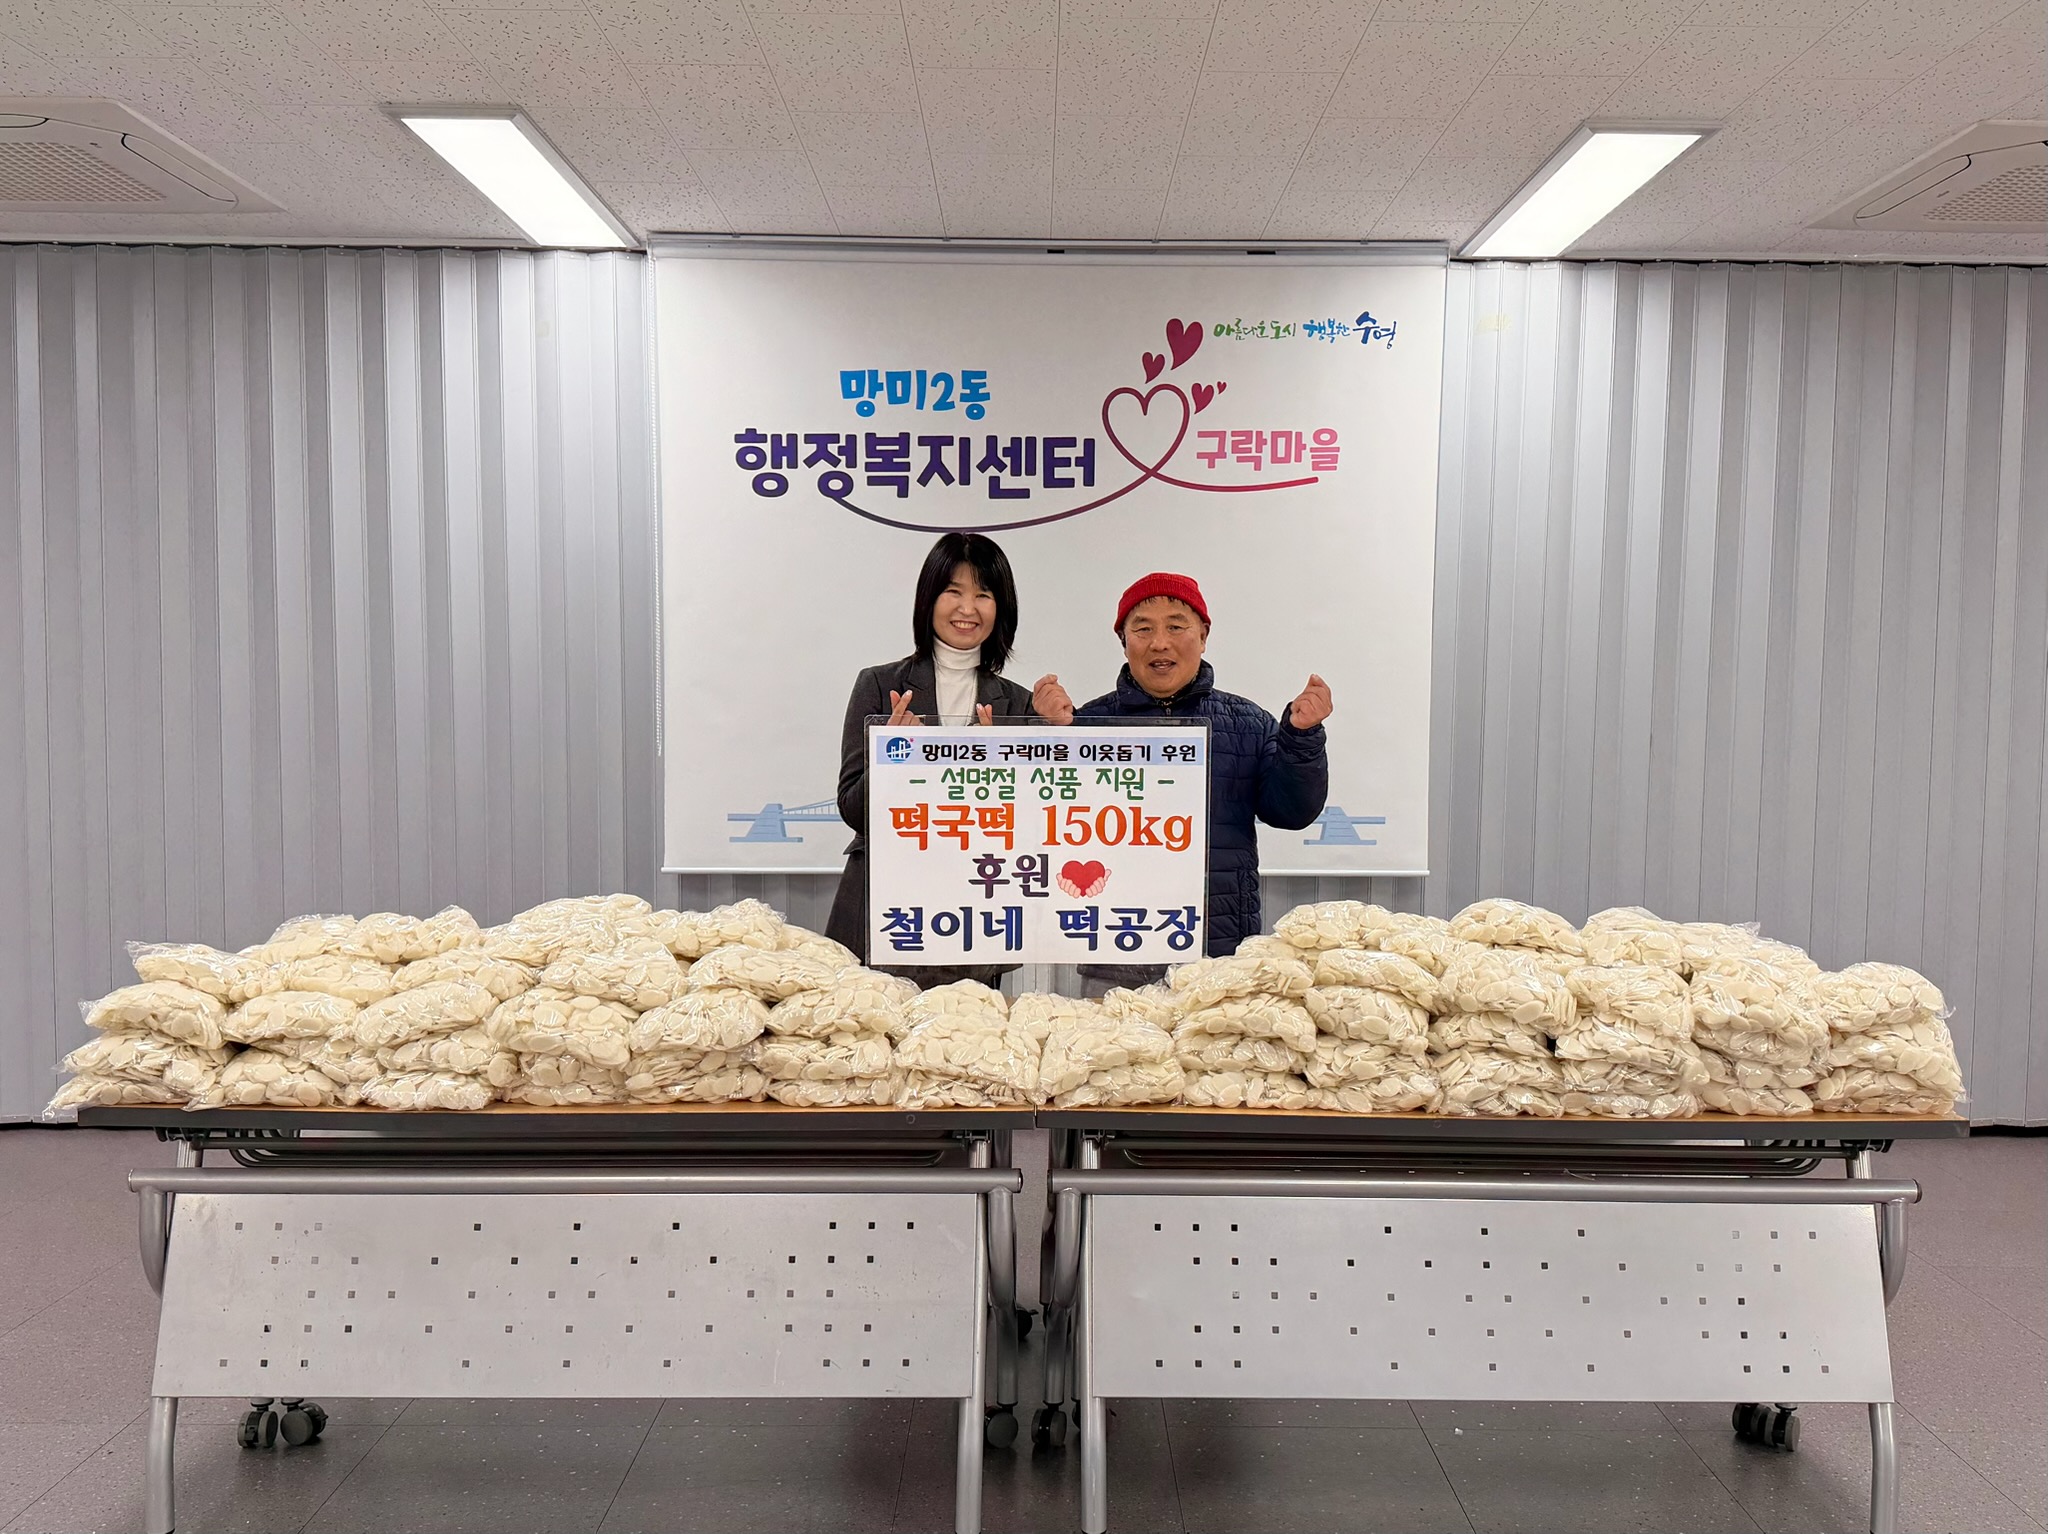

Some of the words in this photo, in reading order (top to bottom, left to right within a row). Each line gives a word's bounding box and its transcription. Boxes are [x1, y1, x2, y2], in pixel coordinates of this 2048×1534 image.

[1213, 317, 1269, 341] 아름다운
[1302, 317, 1350, 344] 행복한
[1352, 311, 1398, 350] 수영
[840, 369, 992, 420] 망미2동
[734, 427, 1096, 499] 행정복지센터
[1197, 428, 1341, 473] 구락마을
[922, 744, 988, 762] 망미2동
[997, 744, 1070, 762] 구락마을
[1079, 744, 1152, 762] 이웃돕기
[1161, 744, 1197, 762] 후원
[940, 767, 1016, 800] 설명절
[1030, 767, 1082, 800] 성품
[1095, 767, 1145, 800] 지원
[888, 803, 1015, 851] 떡국떡
[1042, 805, 1193, 852] 150kg
[968, 853, 1050, 899] 후원
[880, 906, 1024, 952] 철이네
[1056, 905, 1201, 952] 떡공장
